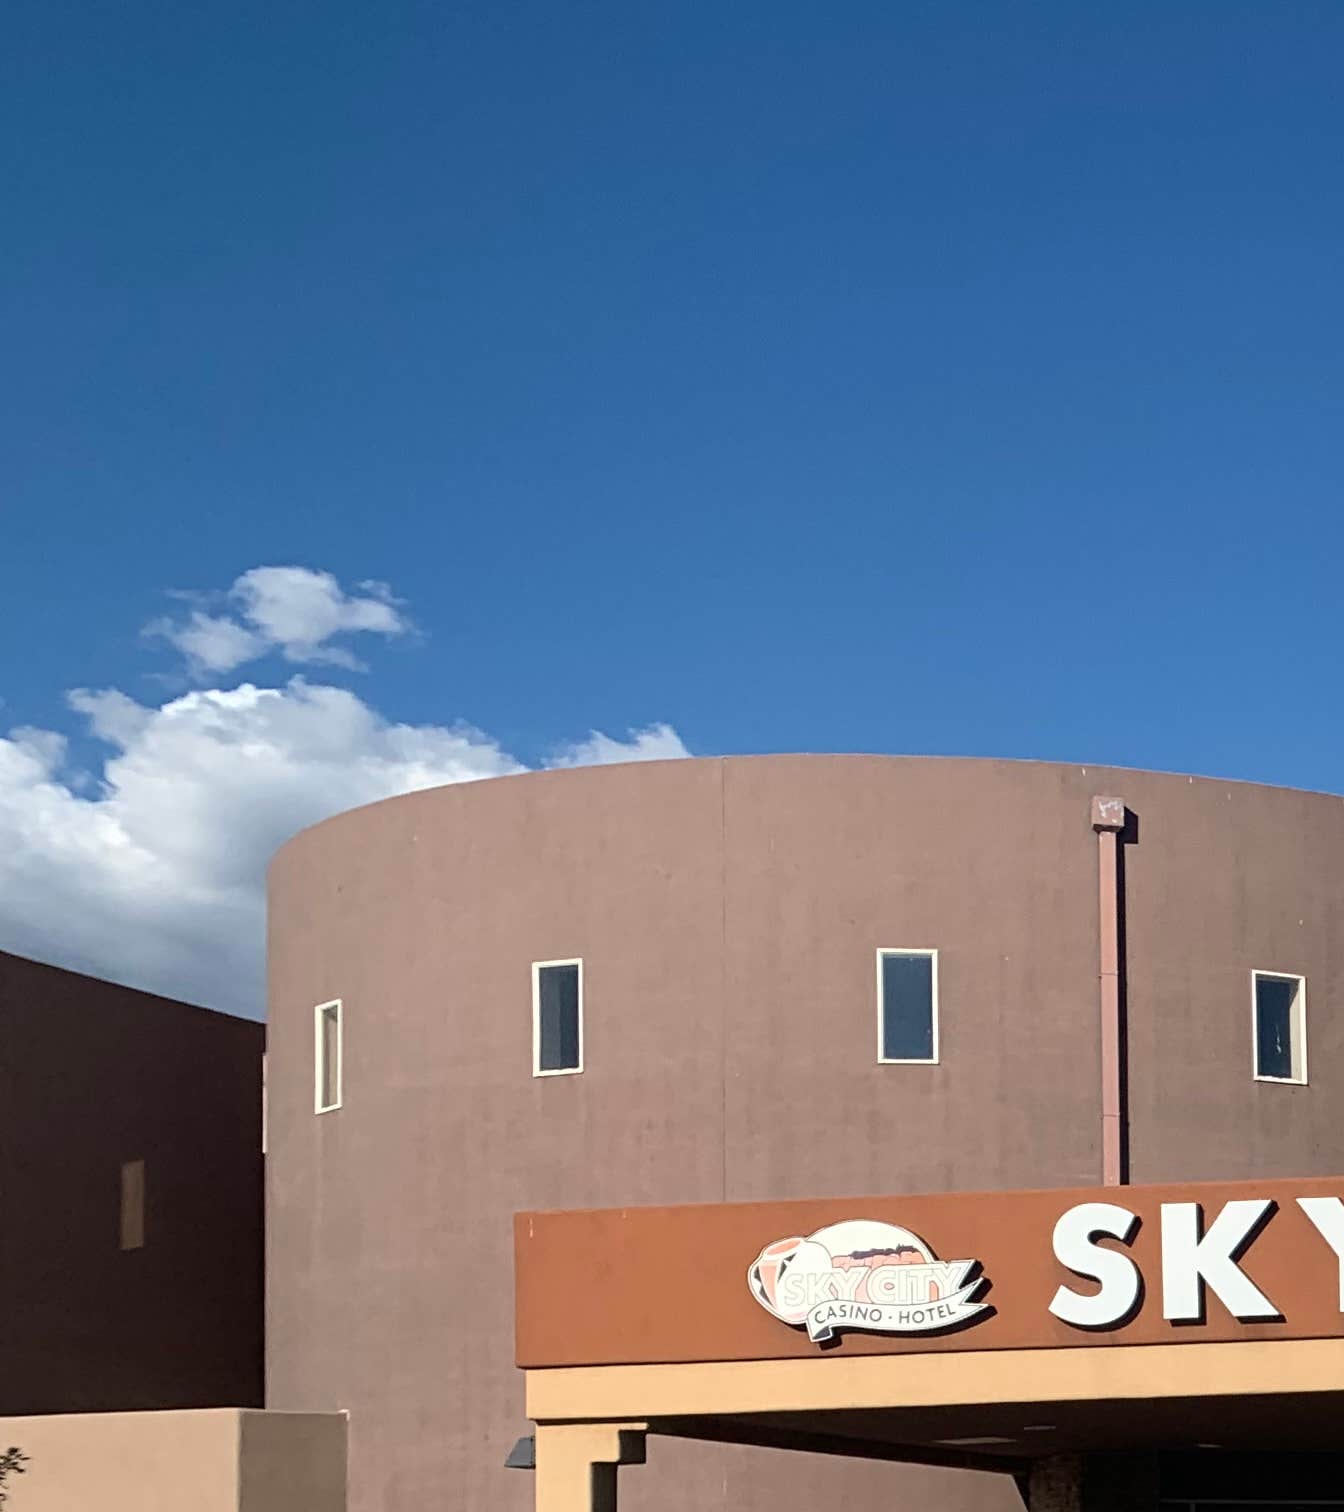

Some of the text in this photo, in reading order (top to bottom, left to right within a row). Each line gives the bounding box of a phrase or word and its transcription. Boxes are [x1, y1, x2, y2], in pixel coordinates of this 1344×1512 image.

[784, 1261, 965, 1306] SKY CITY
[814, 1303, 957, 1325] CASINO HOTEL
